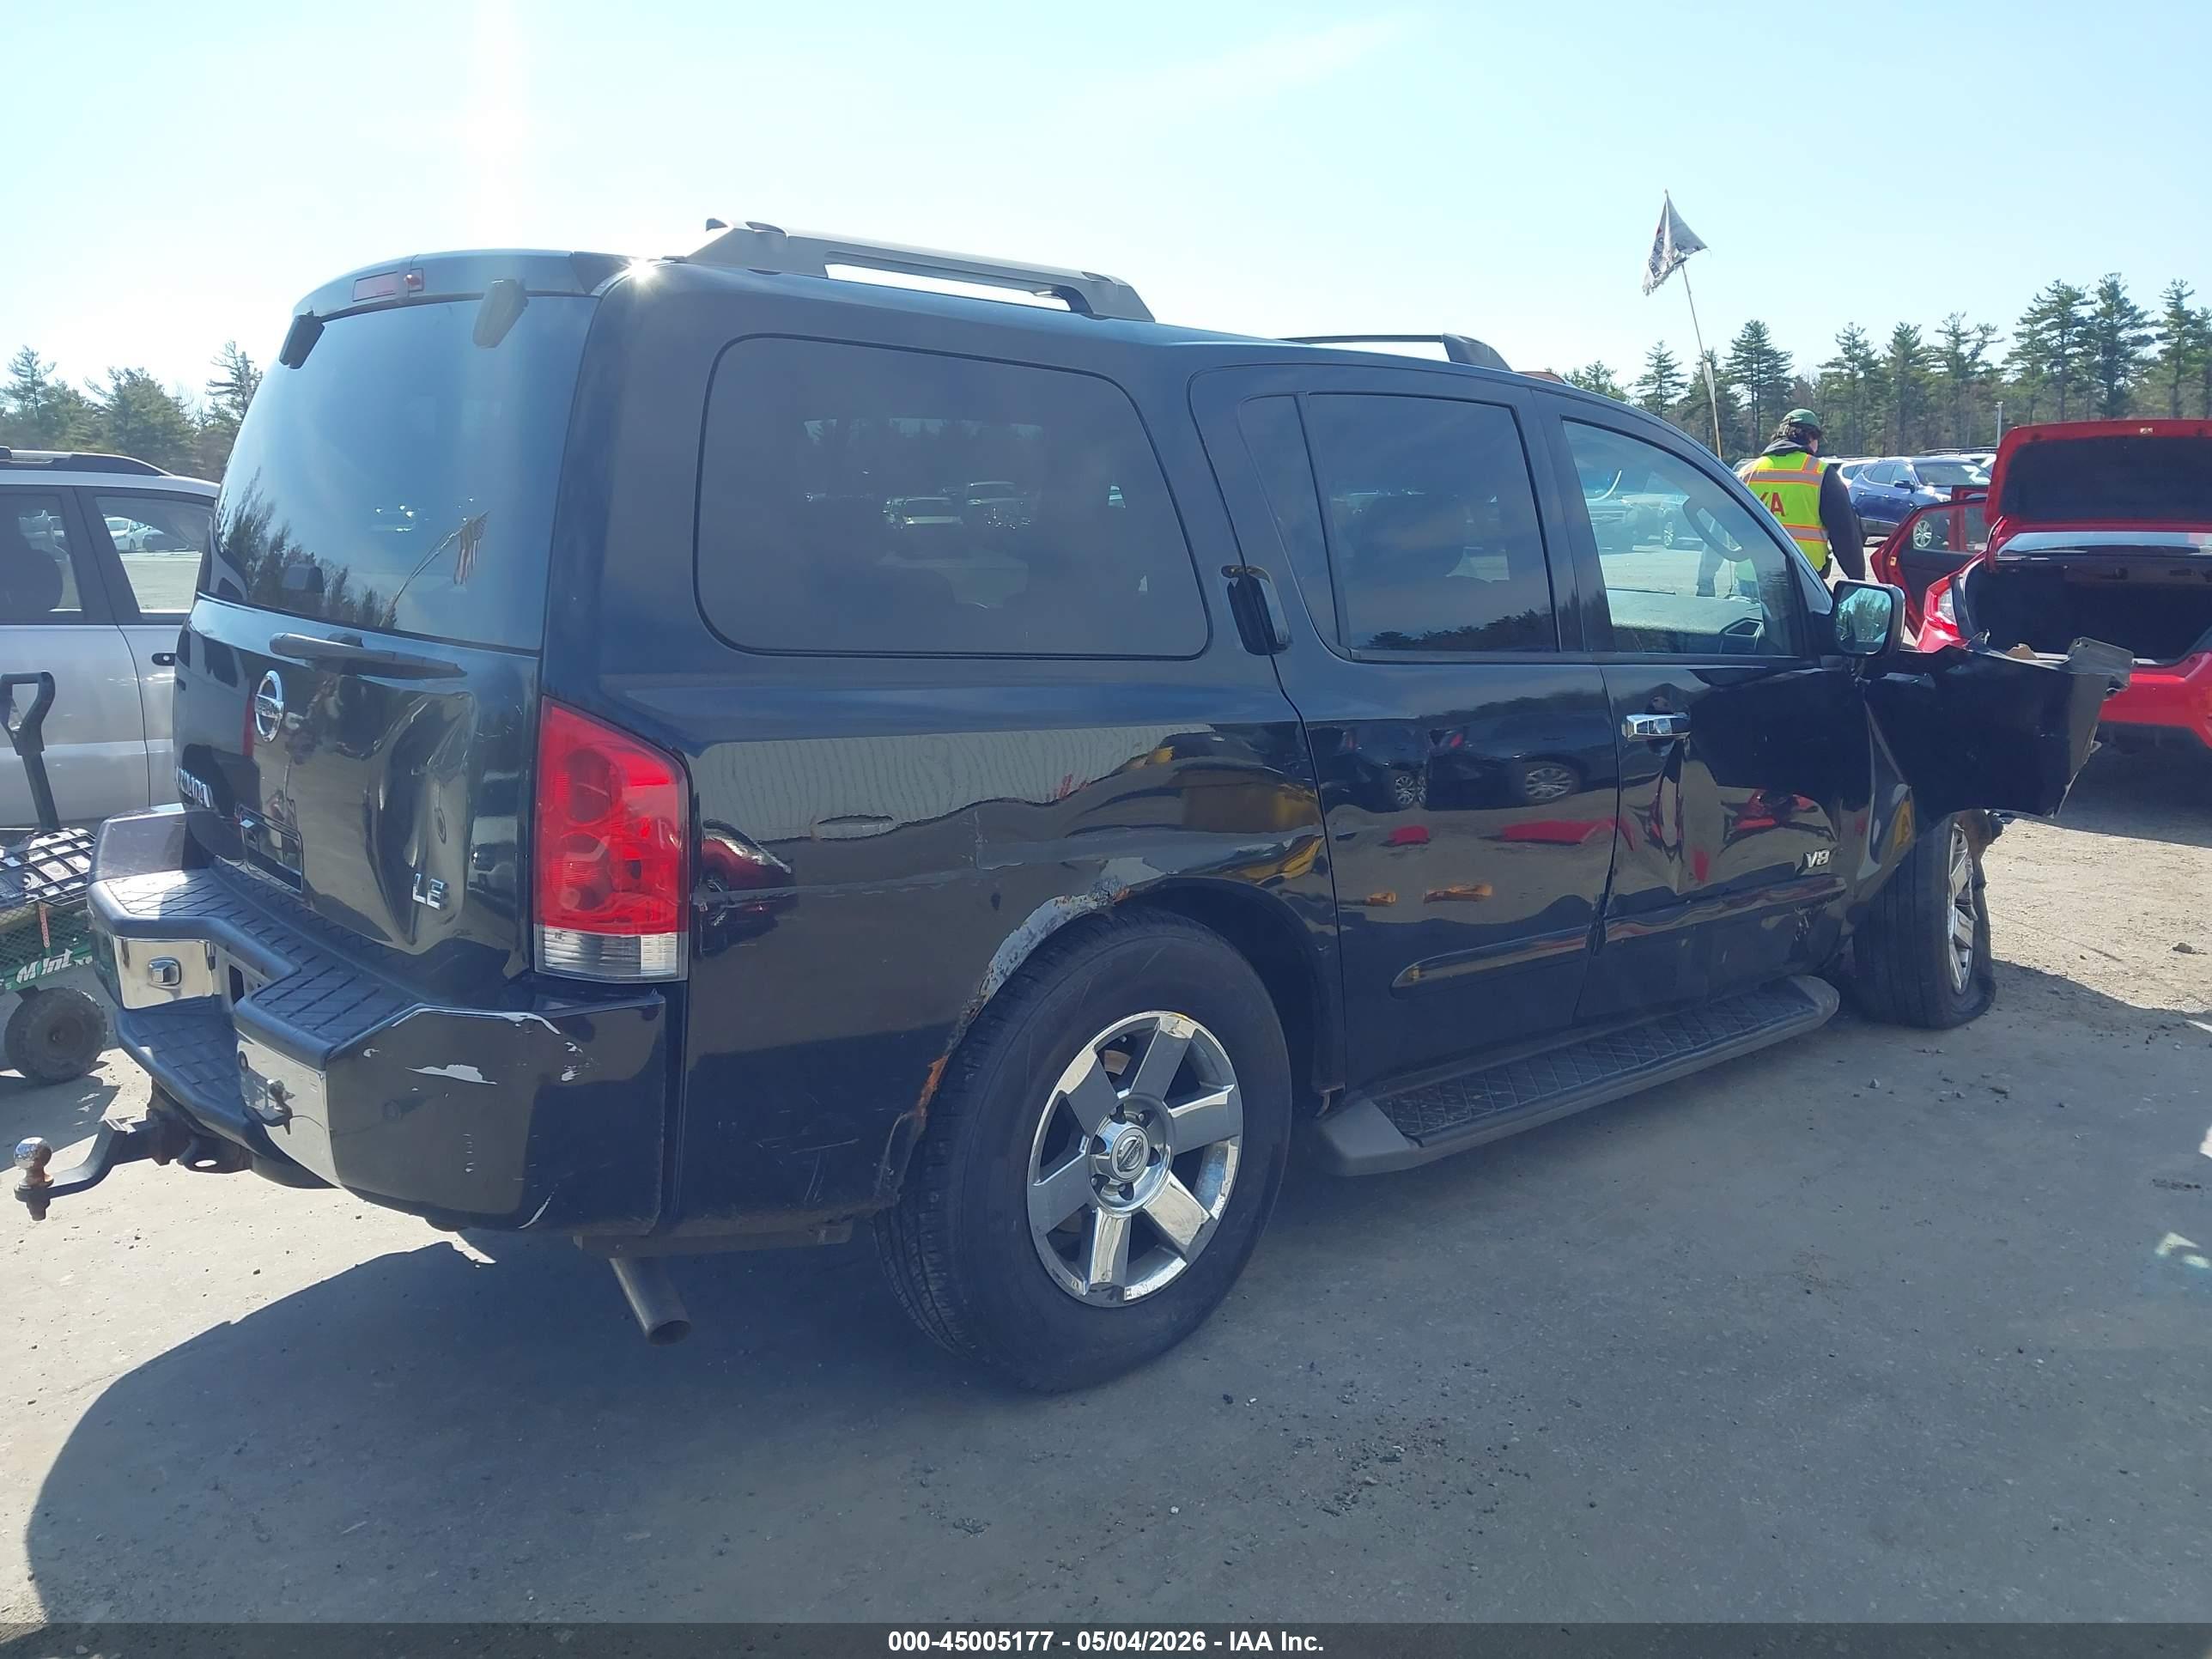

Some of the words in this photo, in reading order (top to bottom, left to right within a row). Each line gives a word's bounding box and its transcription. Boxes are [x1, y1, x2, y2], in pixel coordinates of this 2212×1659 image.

[1759, 491, 1786, 517] A
[1805, 849, 1830, 868] V8
[412, 872, 445, 910] LE
